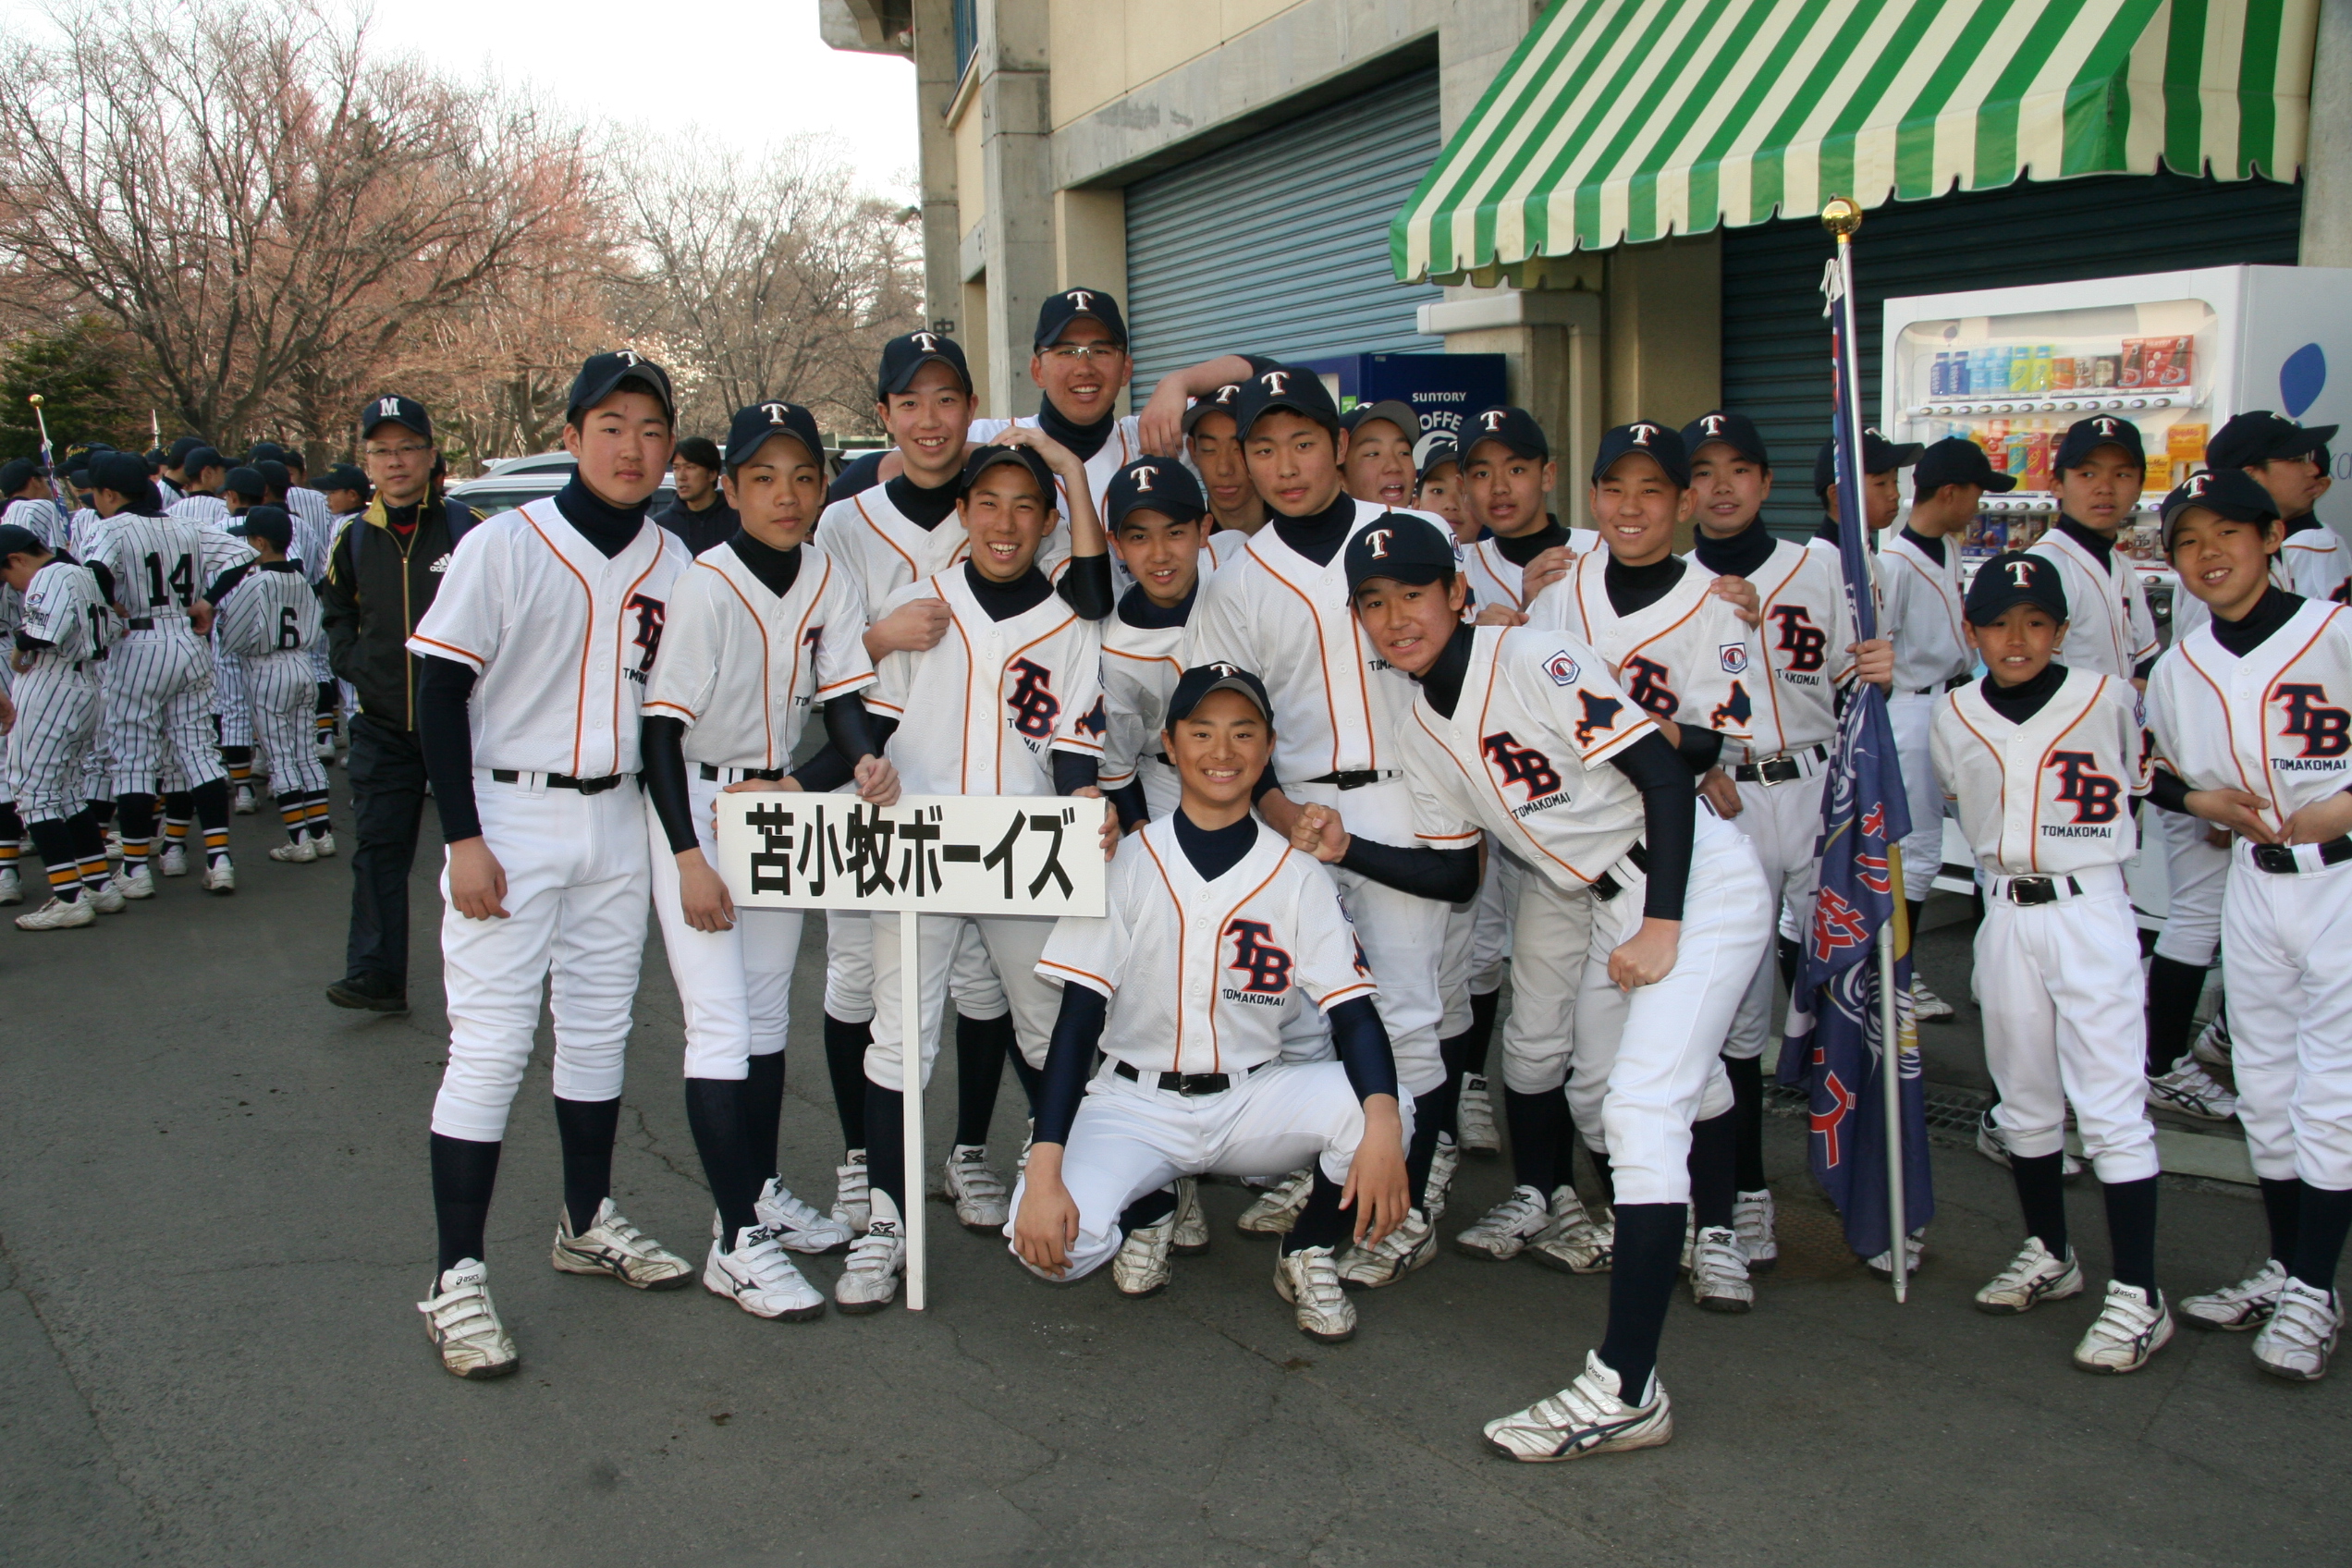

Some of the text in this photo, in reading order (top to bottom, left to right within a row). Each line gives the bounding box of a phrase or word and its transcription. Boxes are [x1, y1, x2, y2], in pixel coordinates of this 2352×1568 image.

[1067, 290, 1094, 312] T
[912, 332, 938, 352] T
[1261, 371, 1290, 397] T
[380, 398, 400, 416] M
[1412, 392, 1466, 403] SUNTORY
[761, 402, 790, 426] T
[1420, 410, 1464, 431] OFFE
[1480, 410, 1507, 432] T
[1699, 415, 1727, 437] T
[2092, 417, 2120, 436] T
[1629, 423, 1660, 446] T
[1131, 465, 1159, 493] T
[2182, 473, 2215, 499] T
[1366, 529, 1392, 559] T
[145, 551, 194, 607] 14
[2005, 560, 2037, 588] T
[278, 606, 300, 650] 6
[1767, 604, 1827, 672] TB
[1210, 663, 1240, 680] T
[1007, 656, 1061, 740] TB
[2268, 682, 2352, 758] TB
[1482, 731, 1562, 802] TB
[2270, 758, 2346, 771] TOMAKOMAI
[2043, 749, 2123, 824] TB
[1512, 791, 1572, 820] TOMAKOMAI
[2040, 825, 2112, 839] TOMAKOMAI
[745, 802, 1075, 900] 苫小牧ボーイズ
[1222, 918, 1294, 995] TB
[1222, 988, 1285, 1007] TOMAKOMAI
